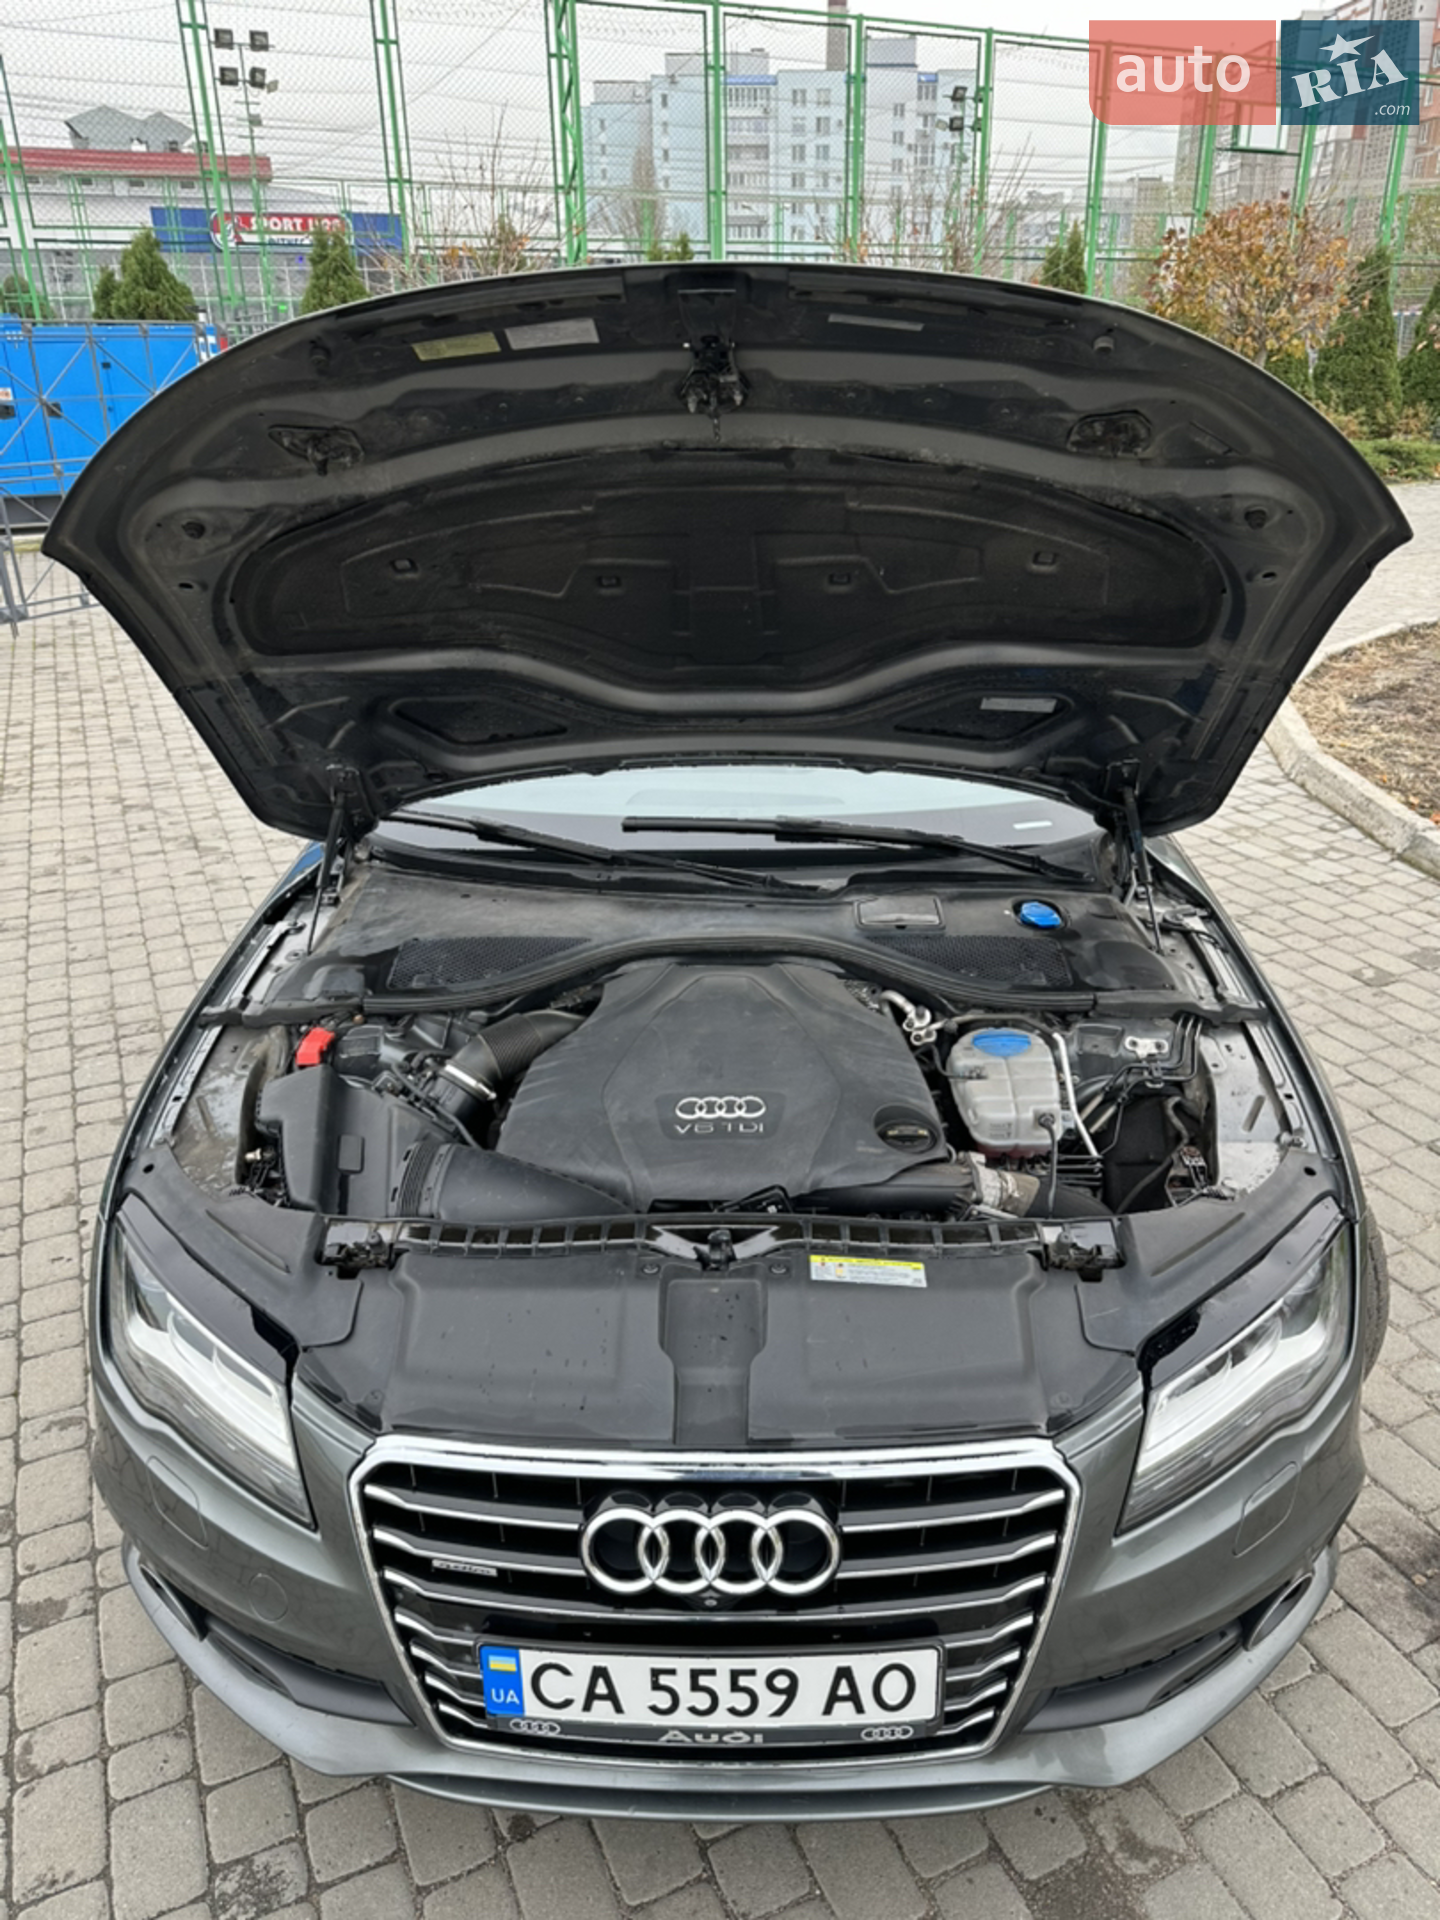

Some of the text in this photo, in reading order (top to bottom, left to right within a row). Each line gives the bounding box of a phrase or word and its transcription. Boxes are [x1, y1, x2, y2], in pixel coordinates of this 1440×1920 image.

[250, 216, 303, 231] SPORT
[673, 1121, 764, 1134] V6 TDI
[491, 1688, 520, 1705] UA
[530, 1662, 916, 1718] CA 5559 AO
